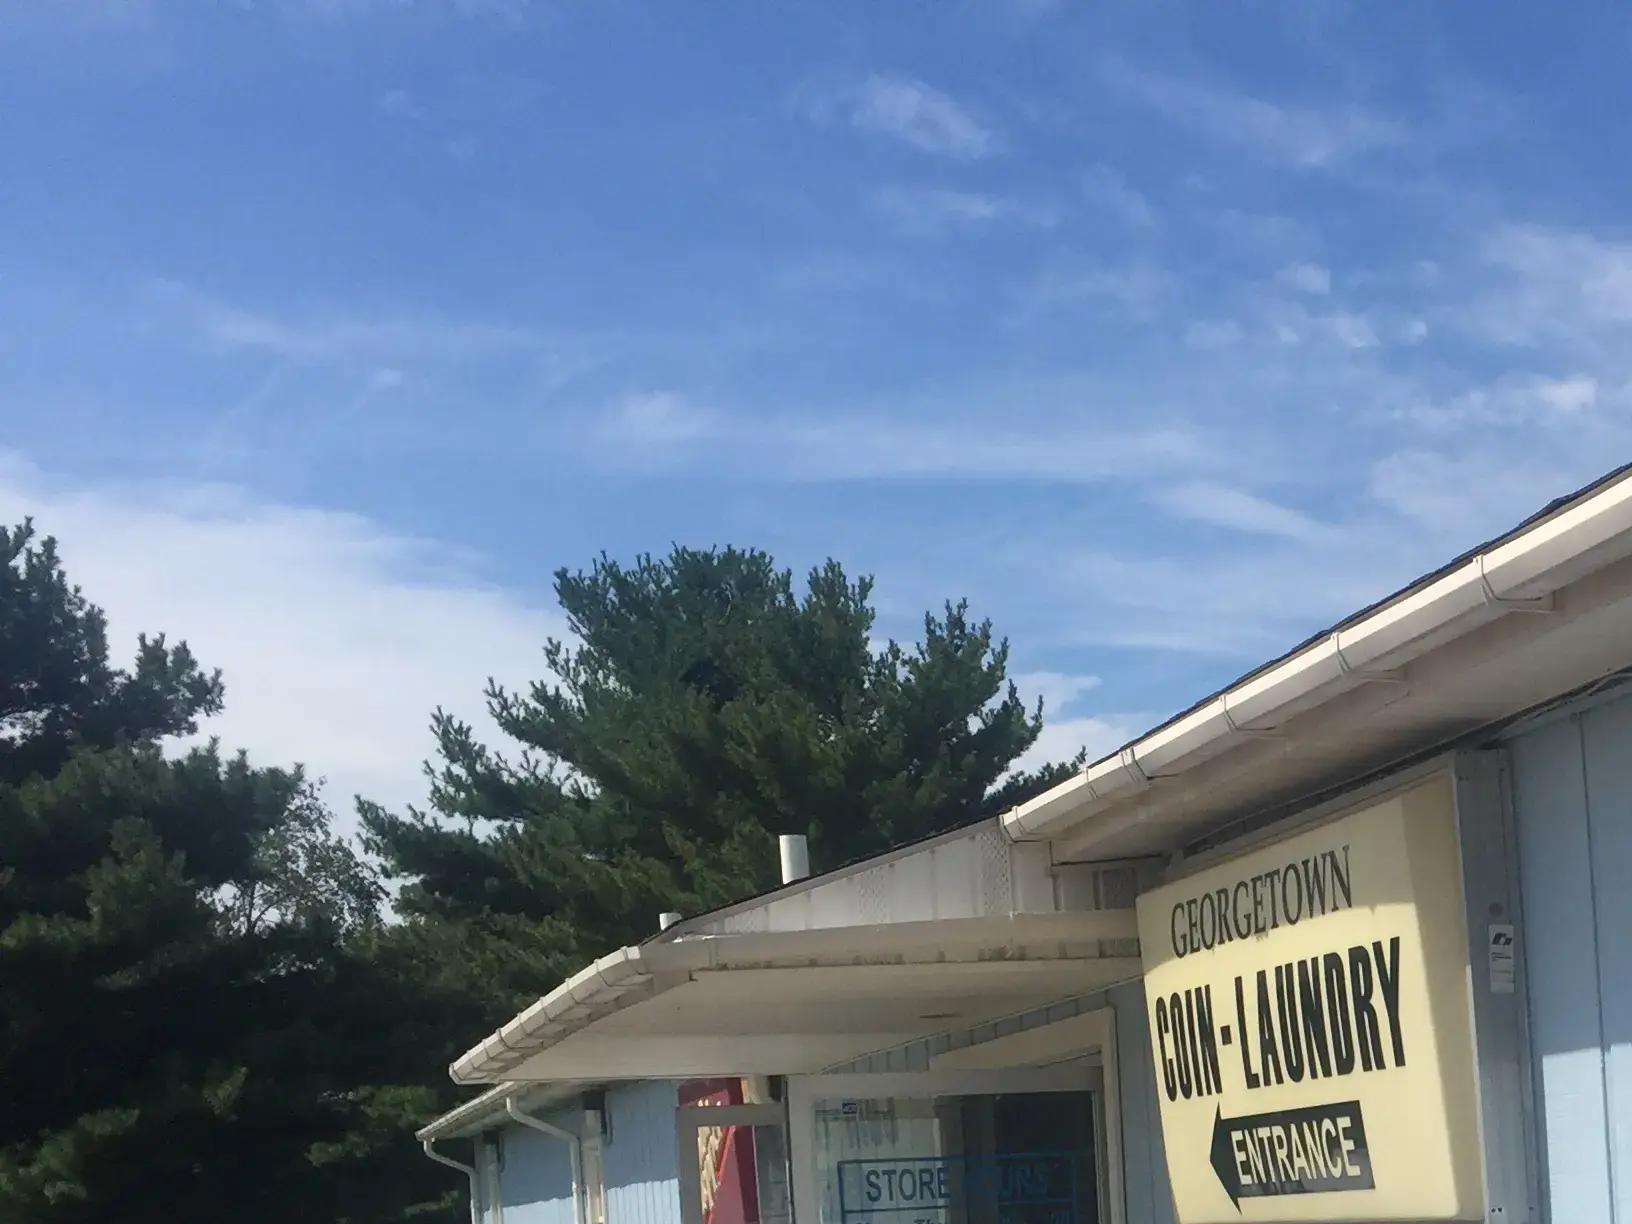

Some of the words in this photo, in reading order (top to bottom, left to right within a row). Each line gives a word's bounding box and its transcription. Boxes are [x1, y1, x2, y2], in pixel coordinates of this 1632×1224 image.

[1171, 845, 1352, 958] GEORGETOWN
[1155, 936, 1406, 1102] COIN-LAUNDRY
[865, 1166, 950, 1202] STORE
[1231, 1116, 1361, 1185] ENTRANCE
